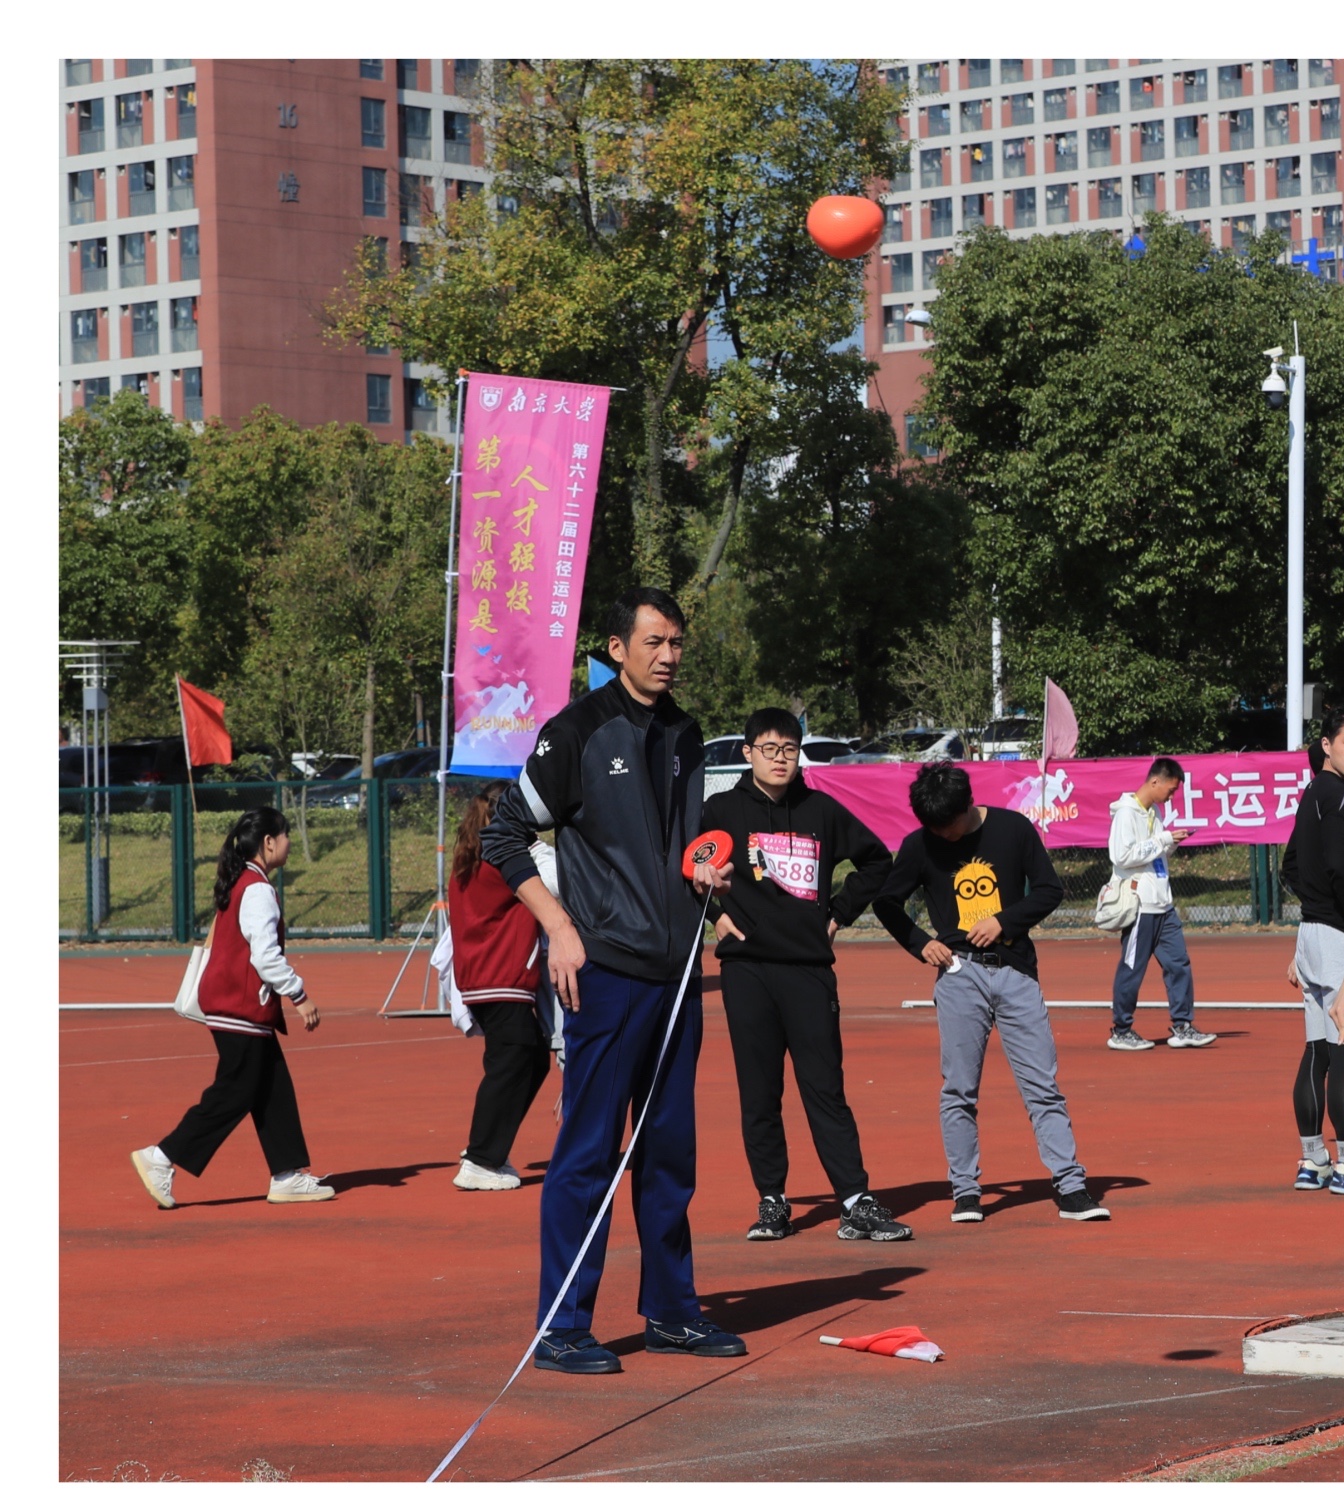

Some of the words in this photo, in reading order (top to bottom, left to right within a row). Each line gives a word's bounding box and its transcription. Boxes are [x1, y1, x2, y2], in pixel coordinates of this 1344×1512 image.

[468, 434, 502, 635] 第一资源是
[505, 465, 549, 616] 人才强校
[549, 442, 590, 638] 第六十二届田径运动会
[609, 767, 629, 775] KELME
[1020, 802, 1079, 822] UNNING
[768, 858, 815, 883] 0588
